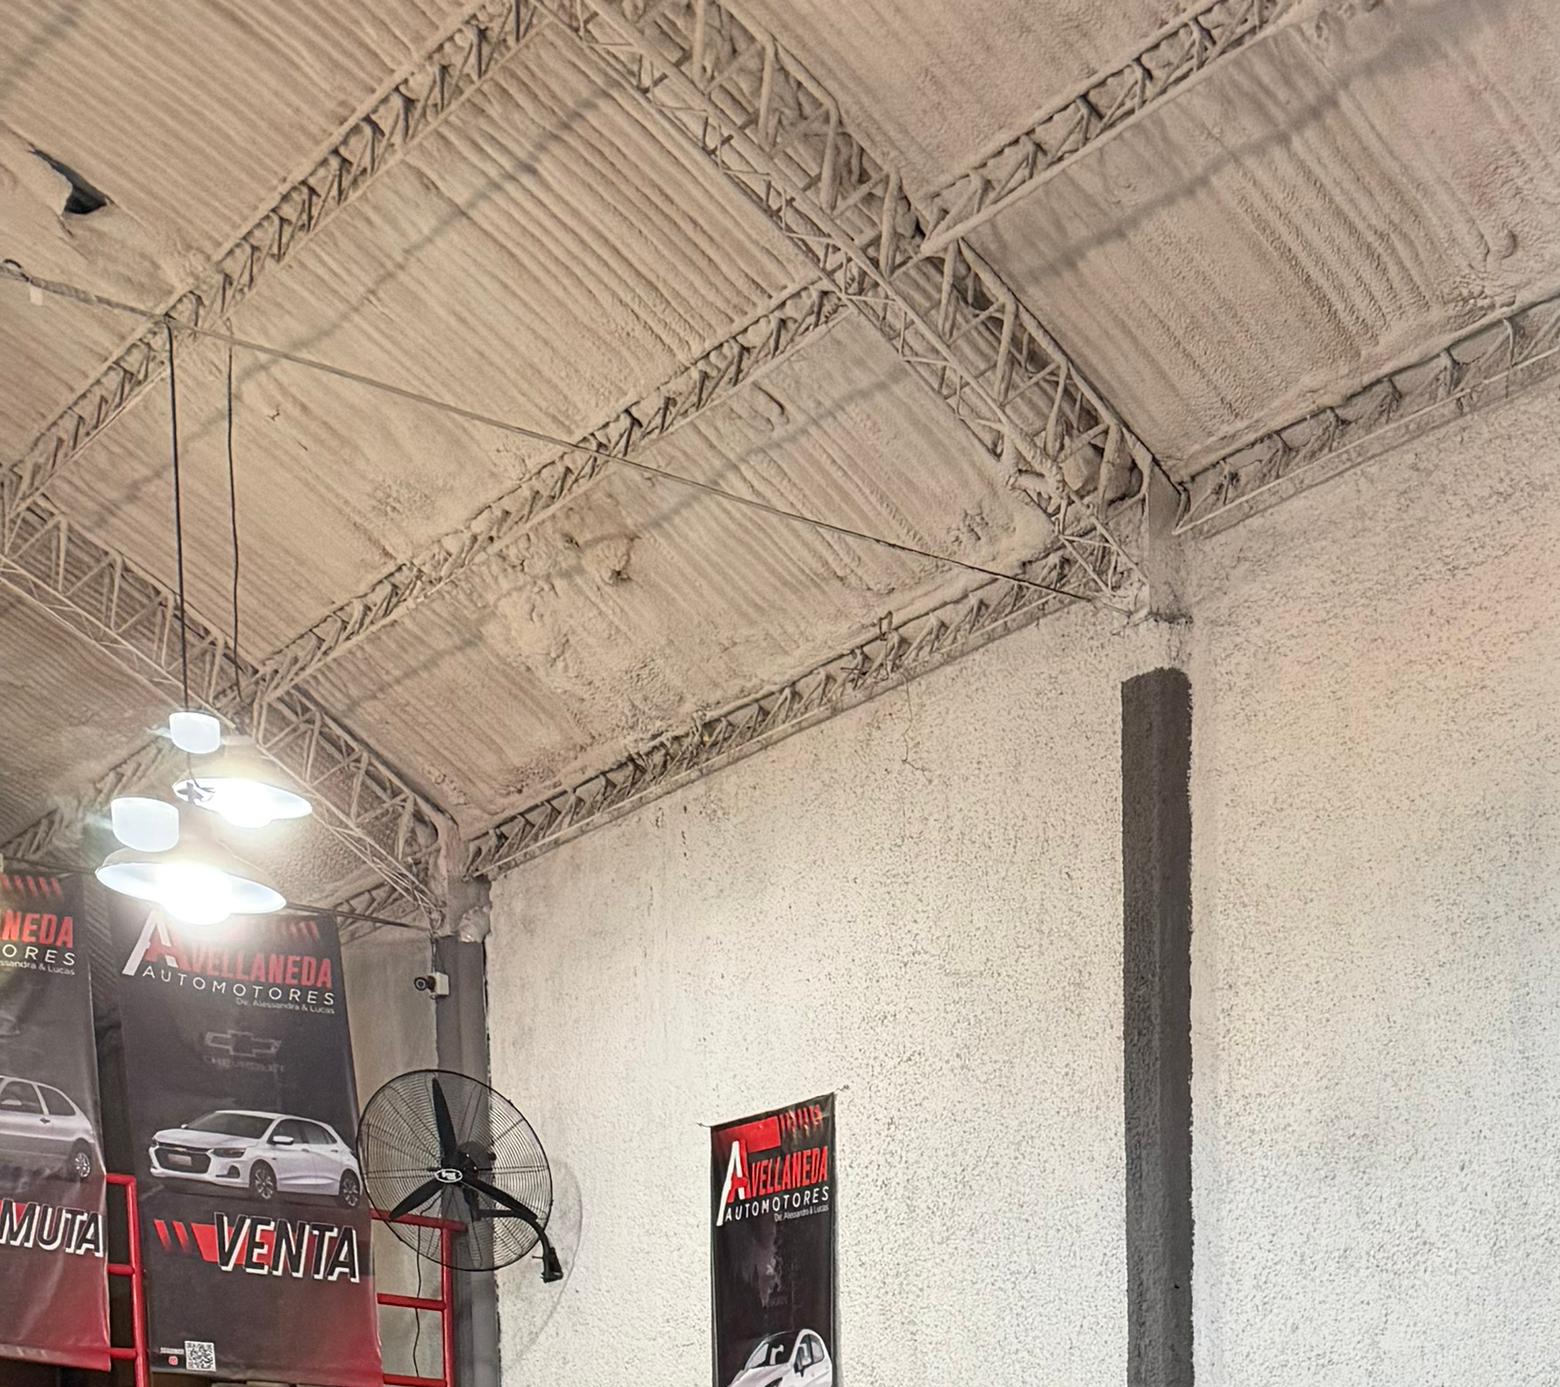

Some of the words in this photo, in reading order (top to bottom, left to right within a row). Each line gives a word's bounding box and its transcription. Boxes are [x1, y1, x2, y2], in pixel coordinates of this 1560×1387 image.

[0, 908, 74, 949] NEDA
[47, 964, 76, 976] Lucas
[142, 965, 335, 1006] AUTOMOTORES
[310, 1005, 335, 1014] Lucas
[724, 1186, 830, 1221] AUTOMOTORES
[0, 1198, 104, 1258] MUTA
[214, 1212, 360, 1284] VENTA
